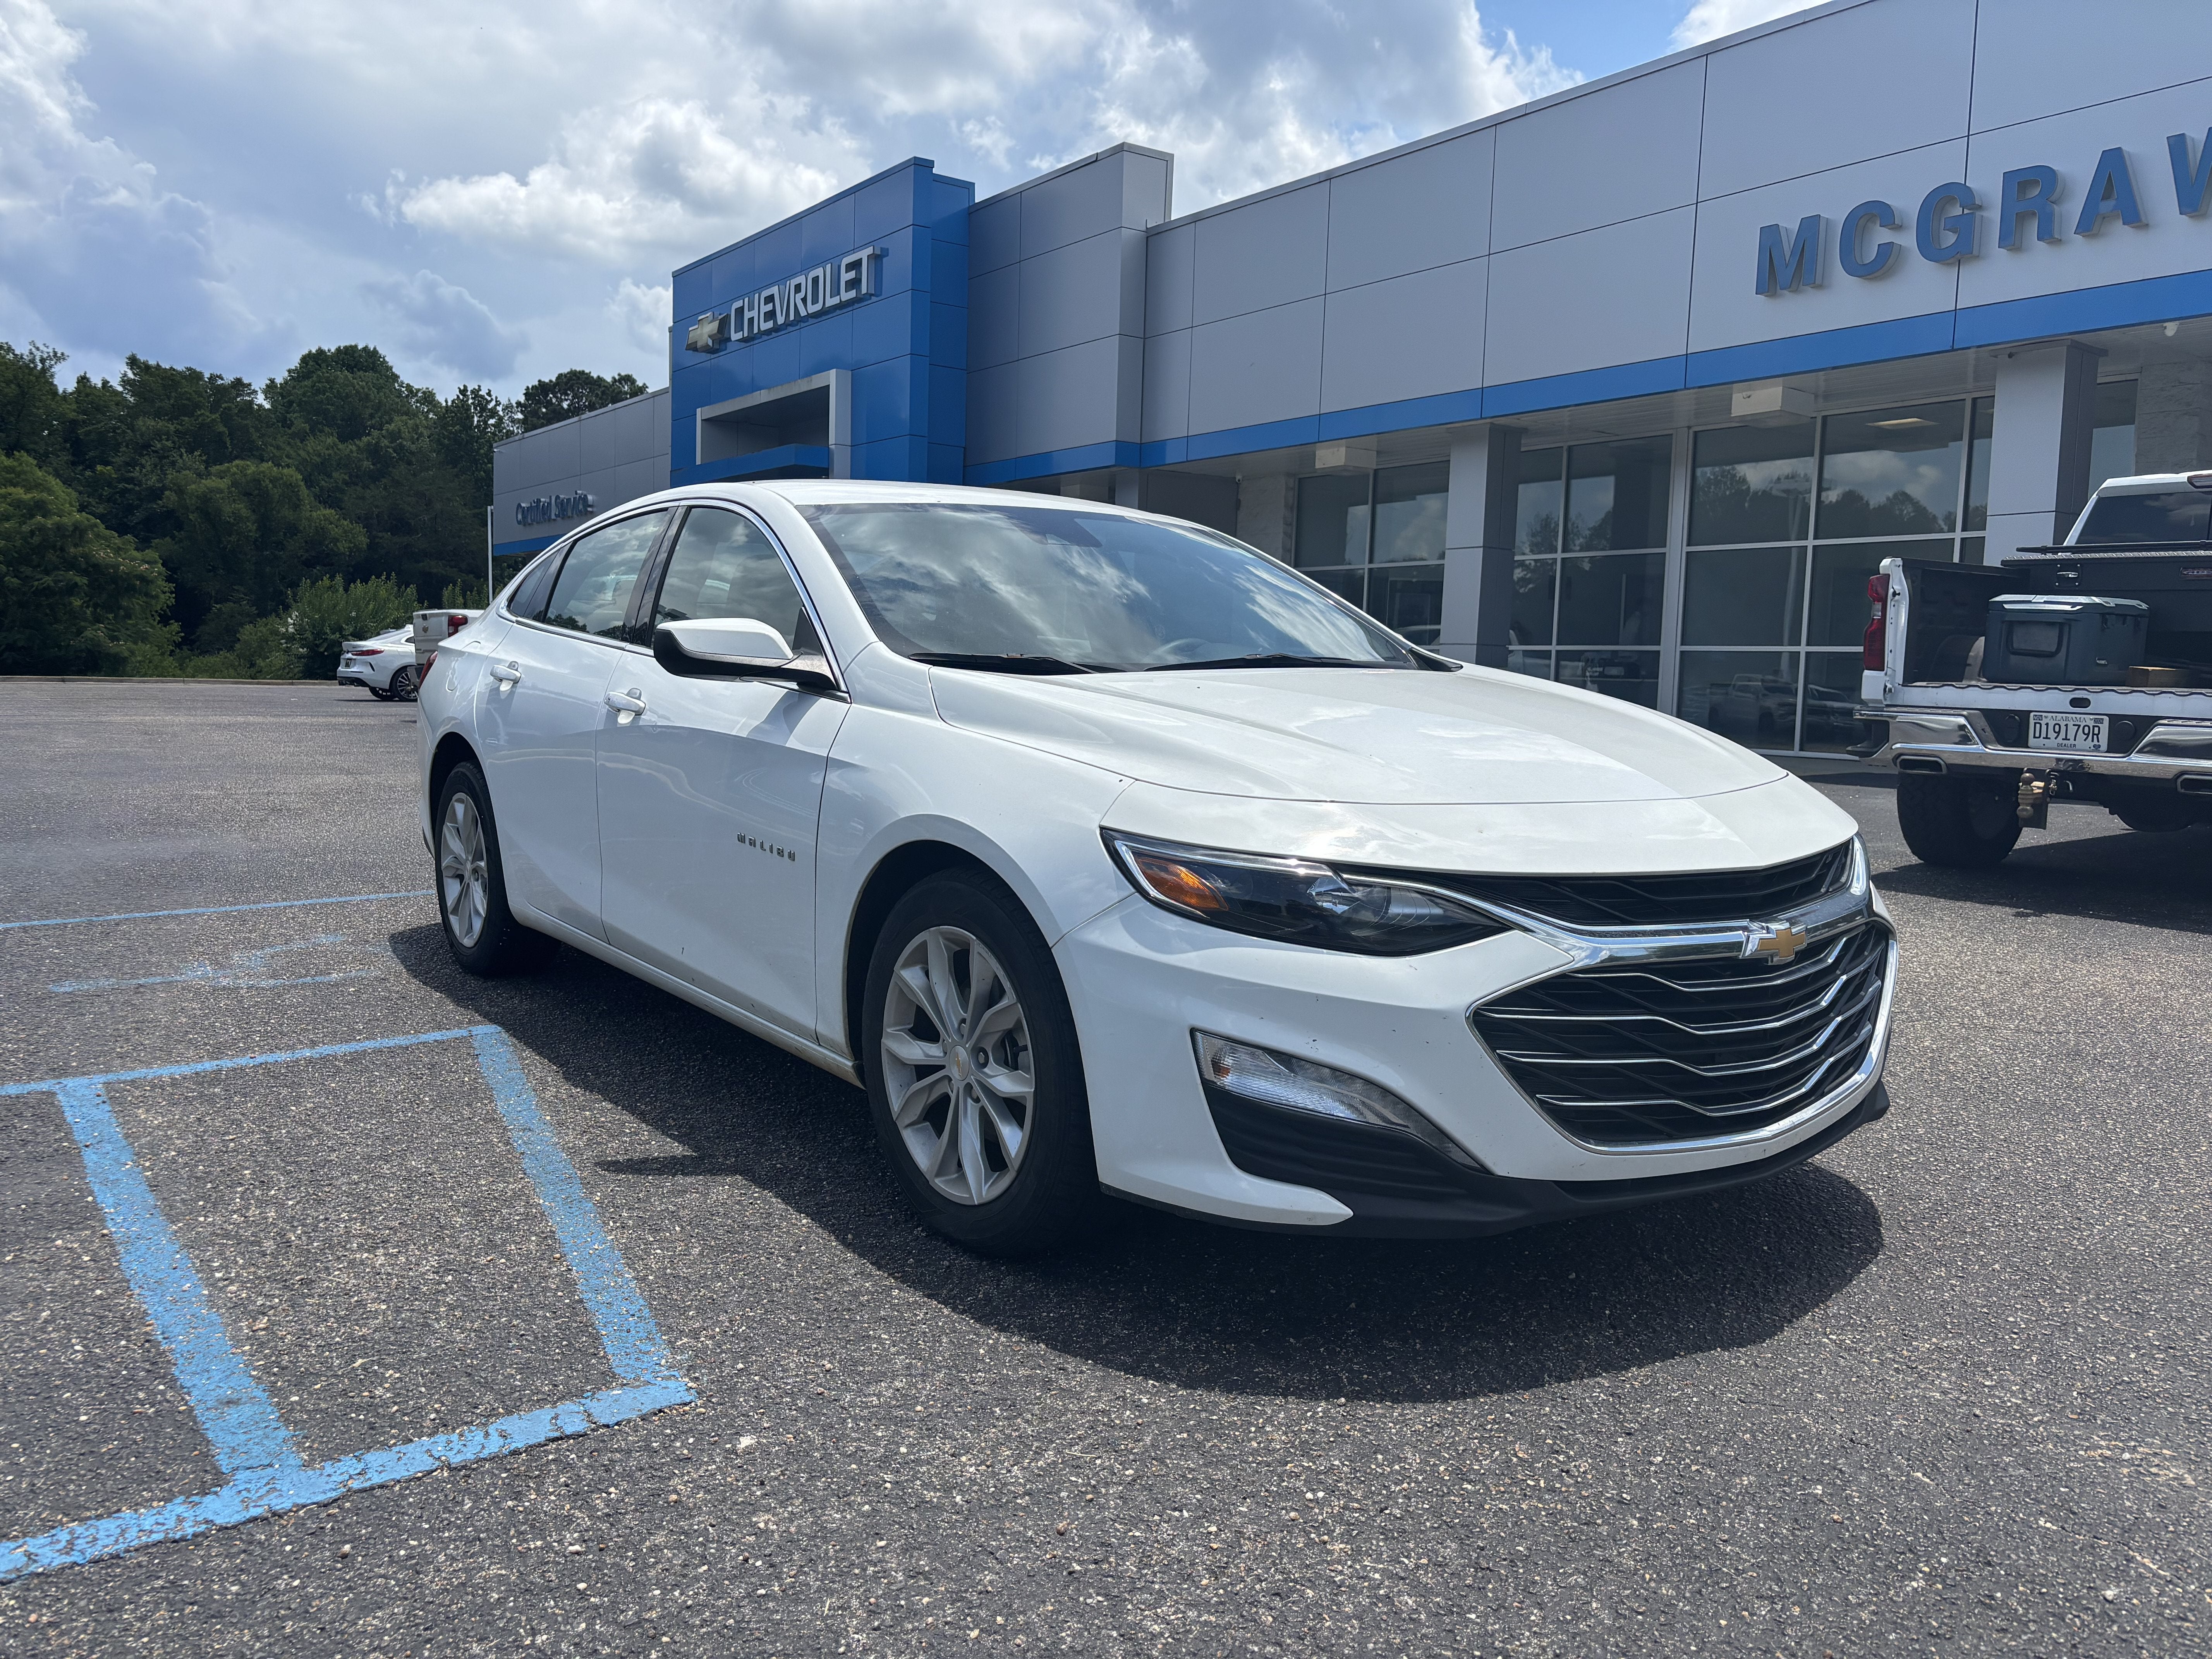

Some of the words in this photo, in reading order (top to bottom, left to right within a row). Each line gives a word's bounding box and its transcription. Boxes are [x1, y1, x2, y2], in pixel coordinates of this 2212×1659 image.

[730, 245, 881, 342] CHEVROLET
[2033, 722, 2100, 743] D19179R
[737, 832, 795, 861] MALIBU
